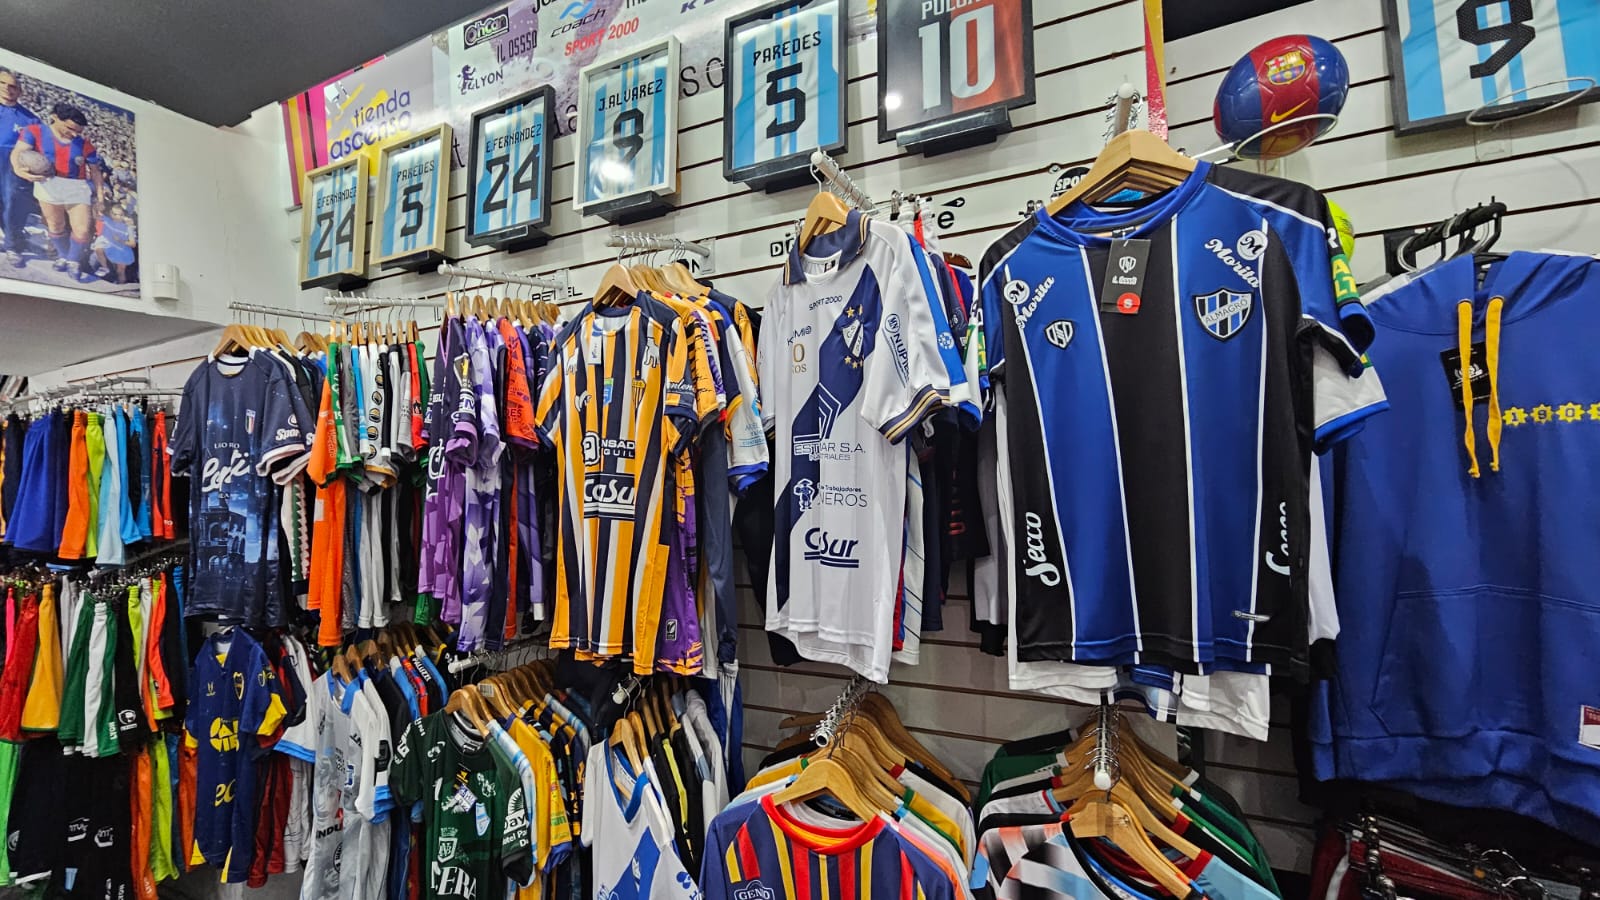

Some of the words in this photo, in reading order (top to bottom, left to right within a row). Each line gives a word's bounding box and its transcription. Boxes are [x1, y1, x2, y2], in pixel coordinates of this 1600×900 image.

[551, 9, 606, 38] coach
[565, 29, 605, 57] SPORT
[608, 17, 639, 40] 2000
[752, 31, 822, 66] PAREDES
[918, 4, 995, 111] 10
[354, 88, 410, 128] tienda
[598, 78, 663, 112] J.ALVAREZ
[766, 62, 806, 139] 5
[613, 107, 644, 164] 9
[482, 144, 541, 214] 24
[314, 203, 356, 261] 24
[400, 182, 424, 238] 5
[1204, 238, 1260, 289] Morita
[1015, 276, 1056, 328] Morita
[1204, 299, 1248, 324] ALMAGRO
